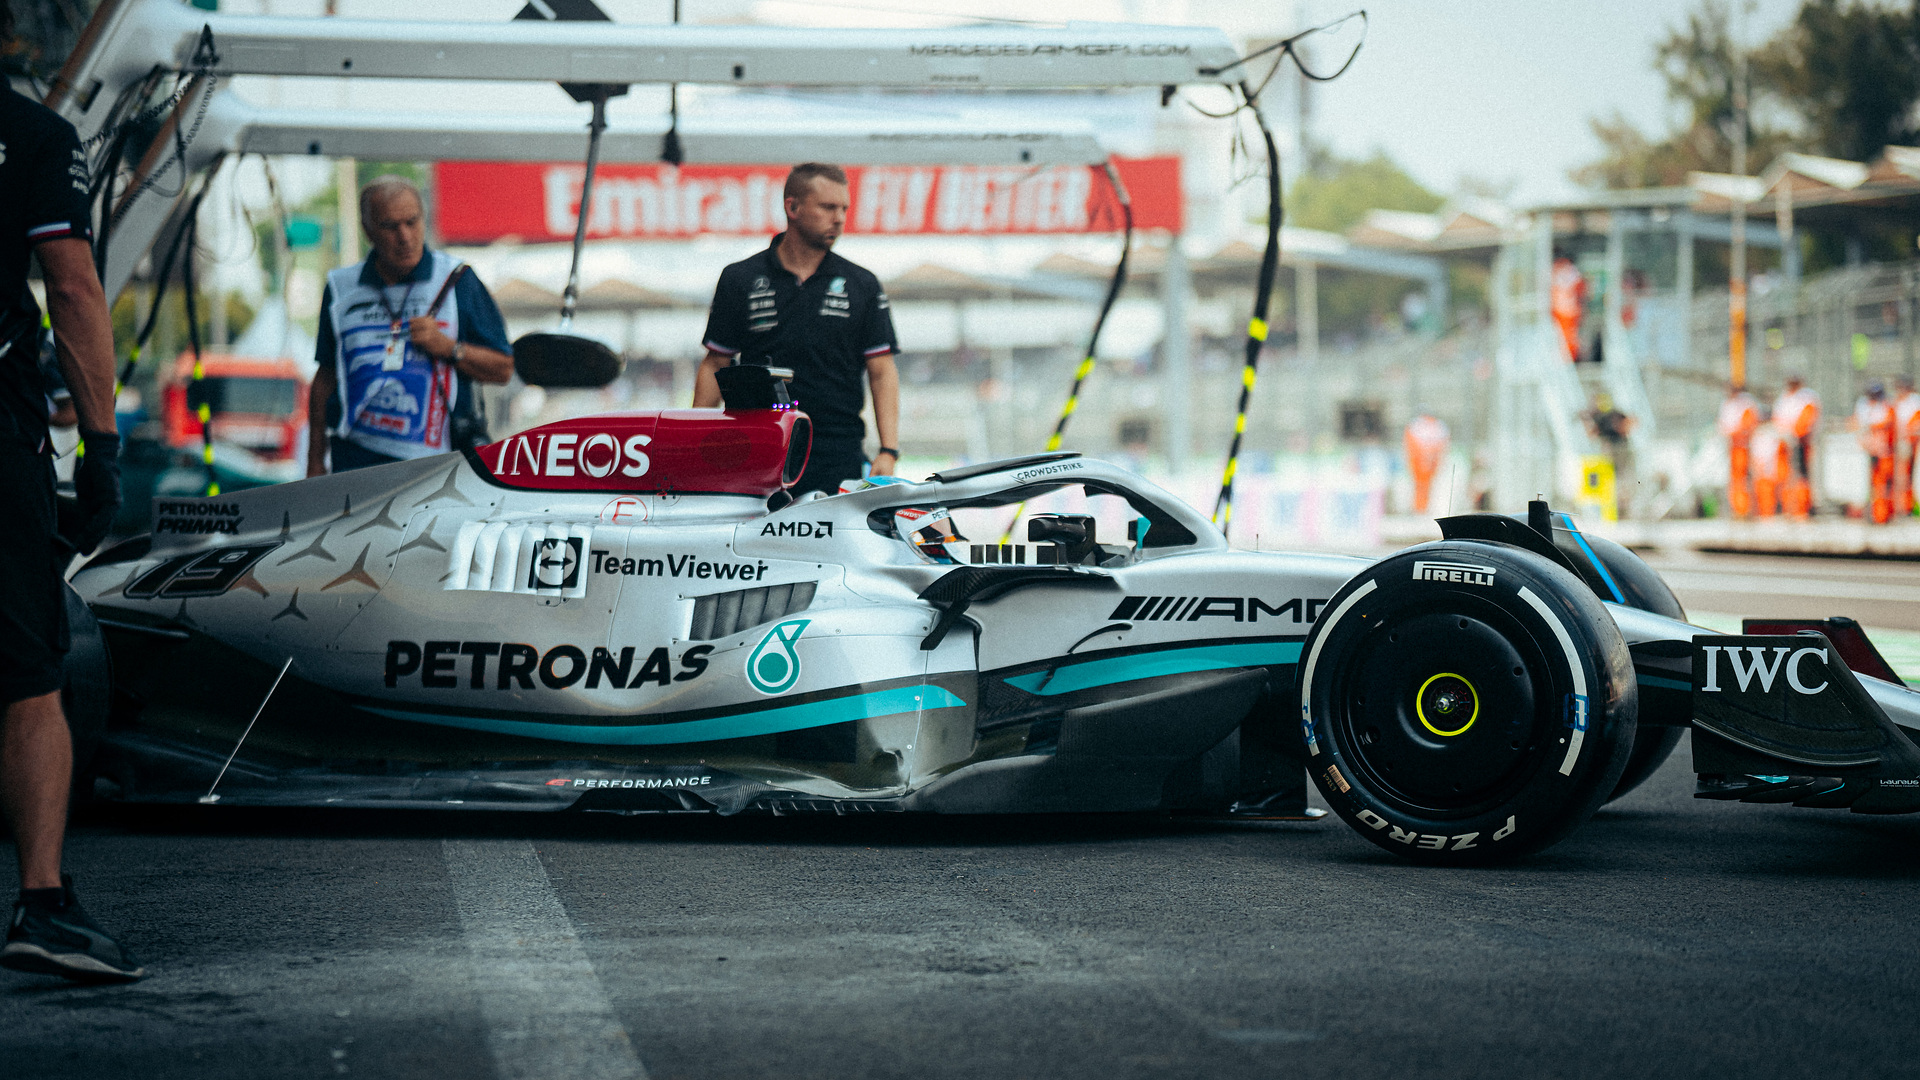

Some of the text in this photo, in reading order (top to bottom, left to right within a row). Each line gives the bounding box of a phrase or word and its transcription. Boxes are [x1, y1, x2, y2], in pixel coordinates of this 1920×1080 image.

[545, 166, 788, 236] Emirat
[493, 433, 653, 478] INEOS
[1017, 462, 1084, 480] CROWDSTRIKE
[158, 503, 240, 516] PETRONAS
[156, 516, 245, 535] PRIMAX
[761, 522, 813, 537] AMD
[123, 539, 286, 599] 19
[591, 550, 769, 581] TeamViewer
[1412, 560, 1497, 587] PIRELLI
[384, 640, 716, 691] PETRONAS
[1701, 645, 1829, 695] IWC
[573, 776, 712, 789] PERFORMANCE
[1355, 808, 1516, 851] P ZERO
